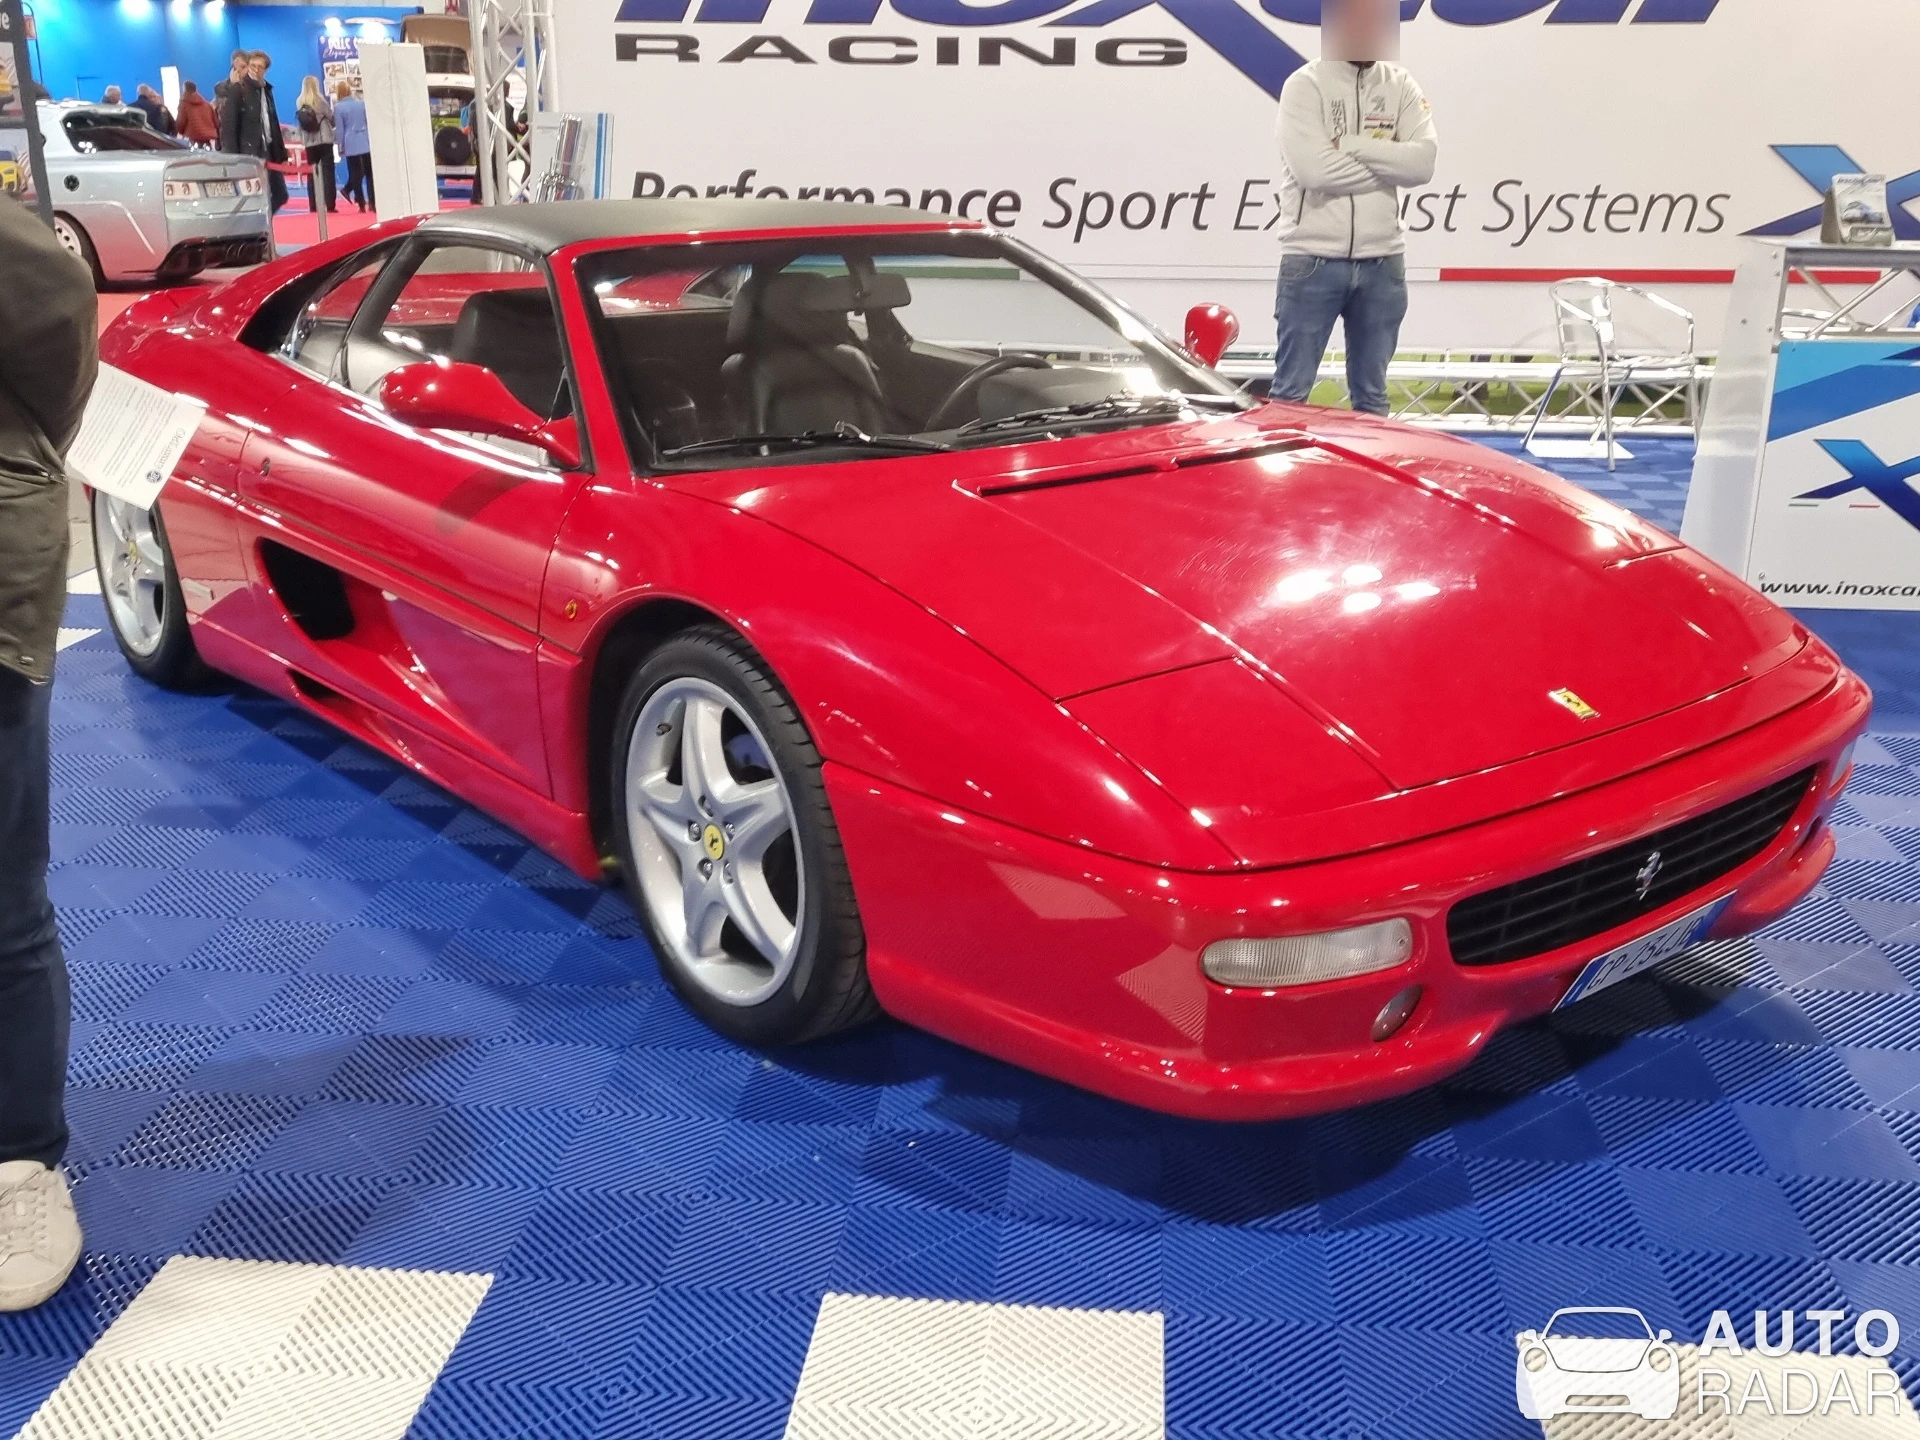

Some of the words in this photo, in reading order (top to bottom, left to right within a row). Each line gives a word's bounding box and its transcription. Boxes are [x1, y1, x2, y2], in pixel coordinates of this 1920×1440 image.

[614, 33, 1188, 67] RACING
[1042, 176, 1216, 244] Sport
[1481, 179, 1732, 247] Systems
